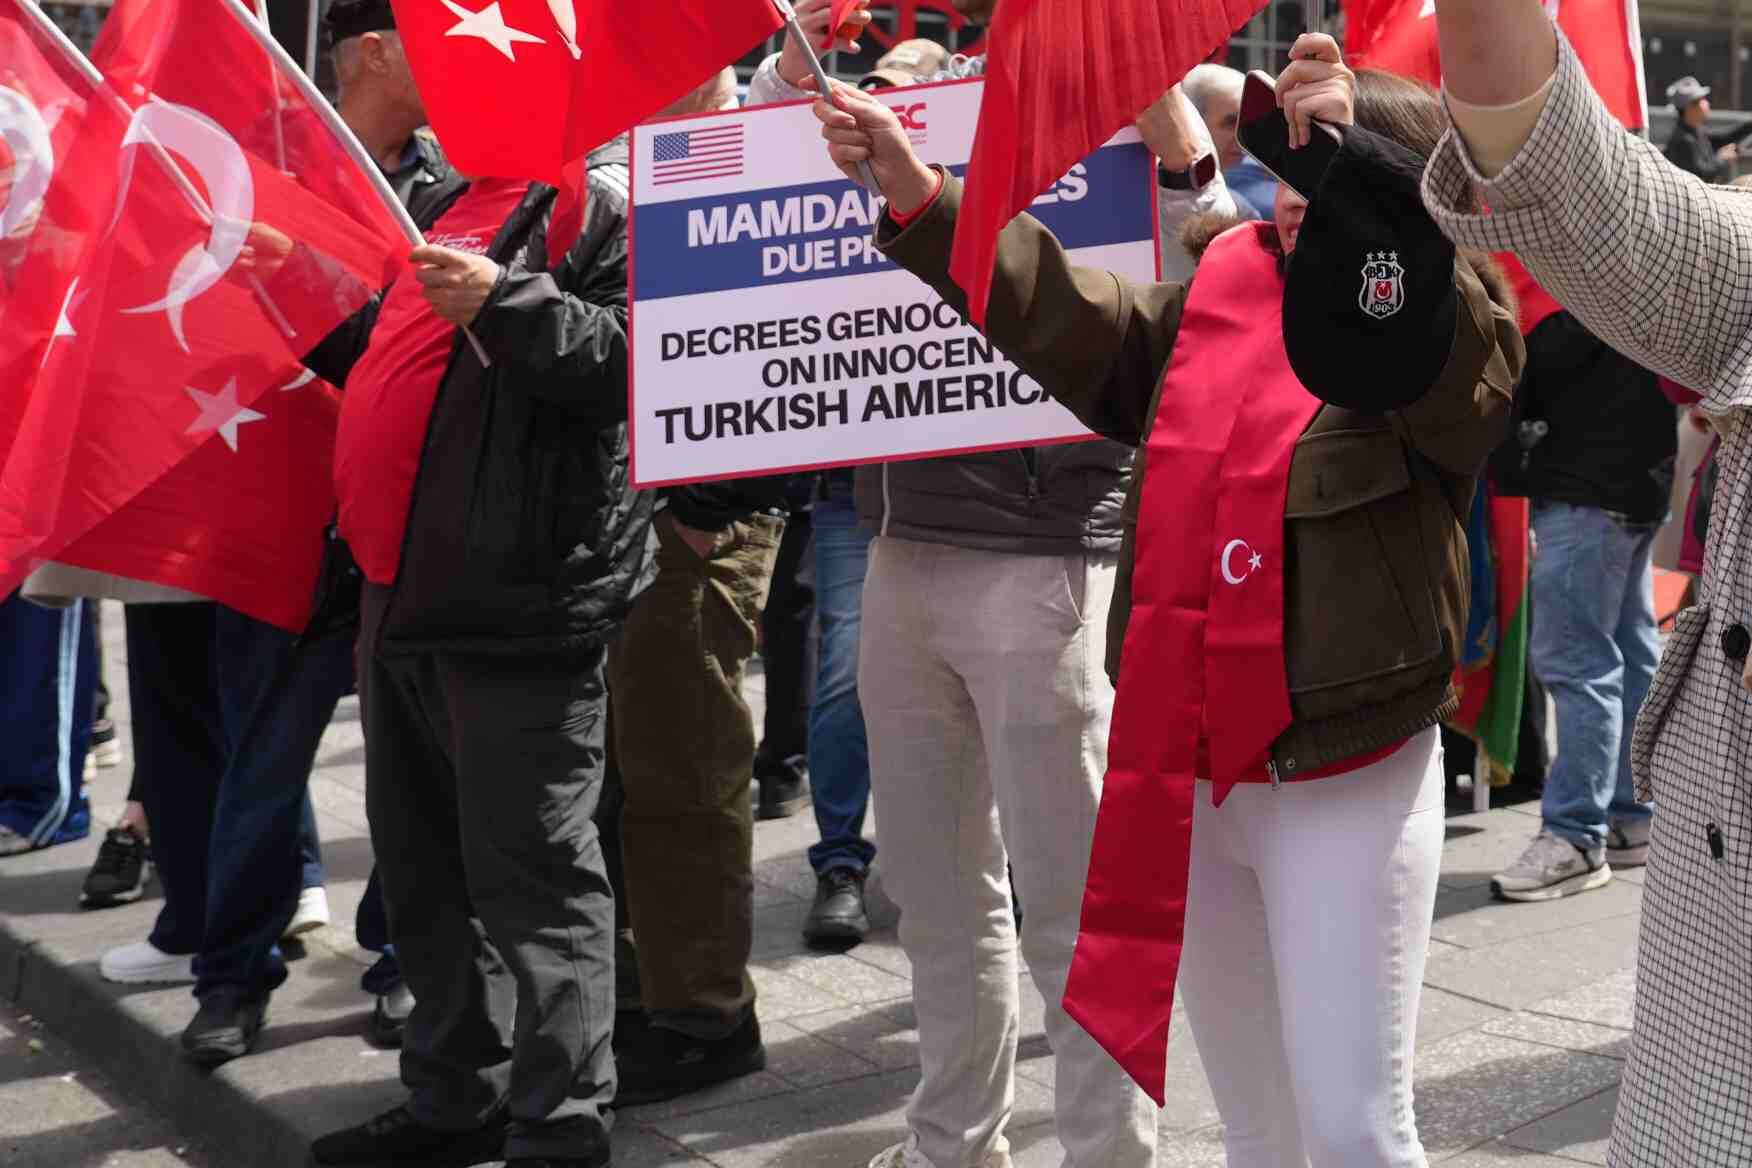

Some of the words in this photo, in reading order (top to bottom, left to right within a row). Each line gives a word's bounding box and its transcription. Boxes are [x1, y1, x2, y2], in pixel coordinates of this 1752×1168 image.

[889, 102, 927, 129] SC
[761, 239, 836, 277] DUE
[660, 314, 822, 362] DECREES
[826, 301, 968, 342] GENOC
[761, 357, 817, 388] ON
[823, 336, 996, 385] INNOCEN
[655, 388, 849, 446] TURKISH
[860, 369, 1051, 423] AMERIC
